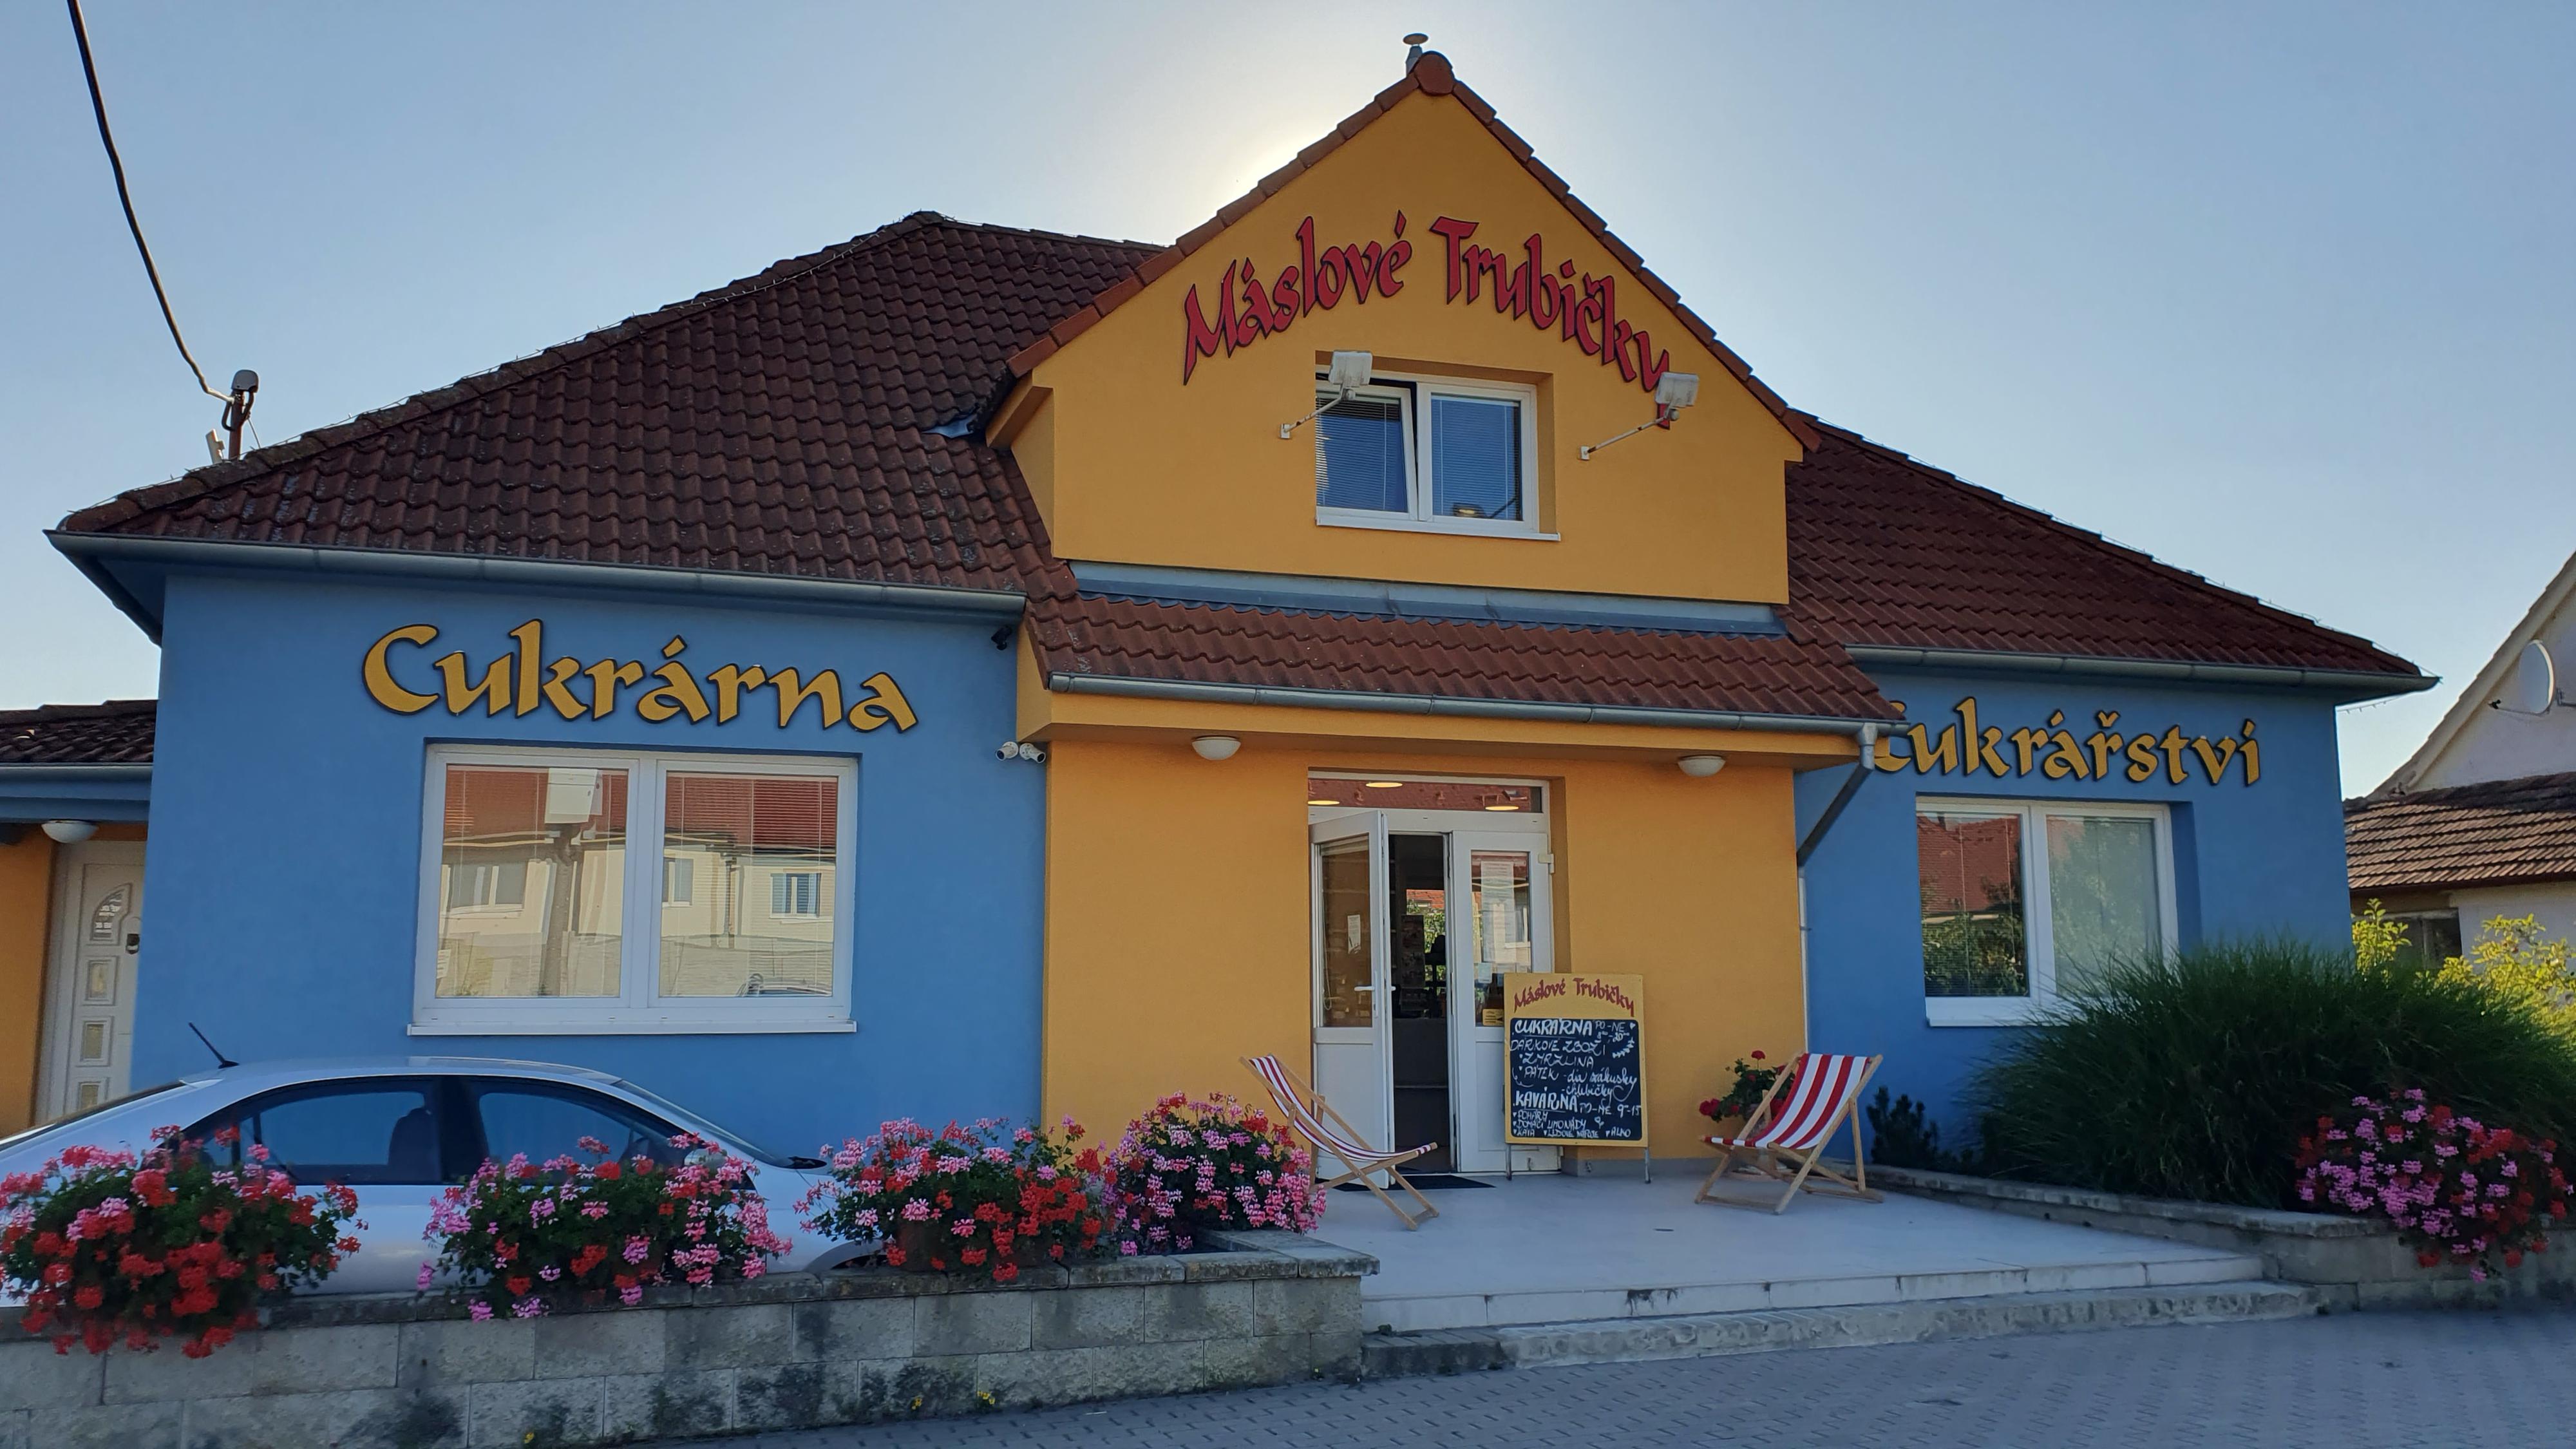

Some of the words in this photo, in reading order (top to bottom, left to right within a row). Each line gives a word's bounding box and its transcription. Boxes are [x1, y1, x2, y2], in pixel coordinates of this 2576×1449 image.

[1183, 209, 1413, 385] Máslové
[1430, 215, 1671, 430] Trubičky
[361, 618, 919, 734] Cukrárna
[1513, 978, 1566, 1013] Máslové
[1573, 978, 1634, 1017] Trubičky
[1522, 1052, 1594, 1069] ZMRZLINA
[1516, 1086, 1578, 1113] KAVÁRNA
